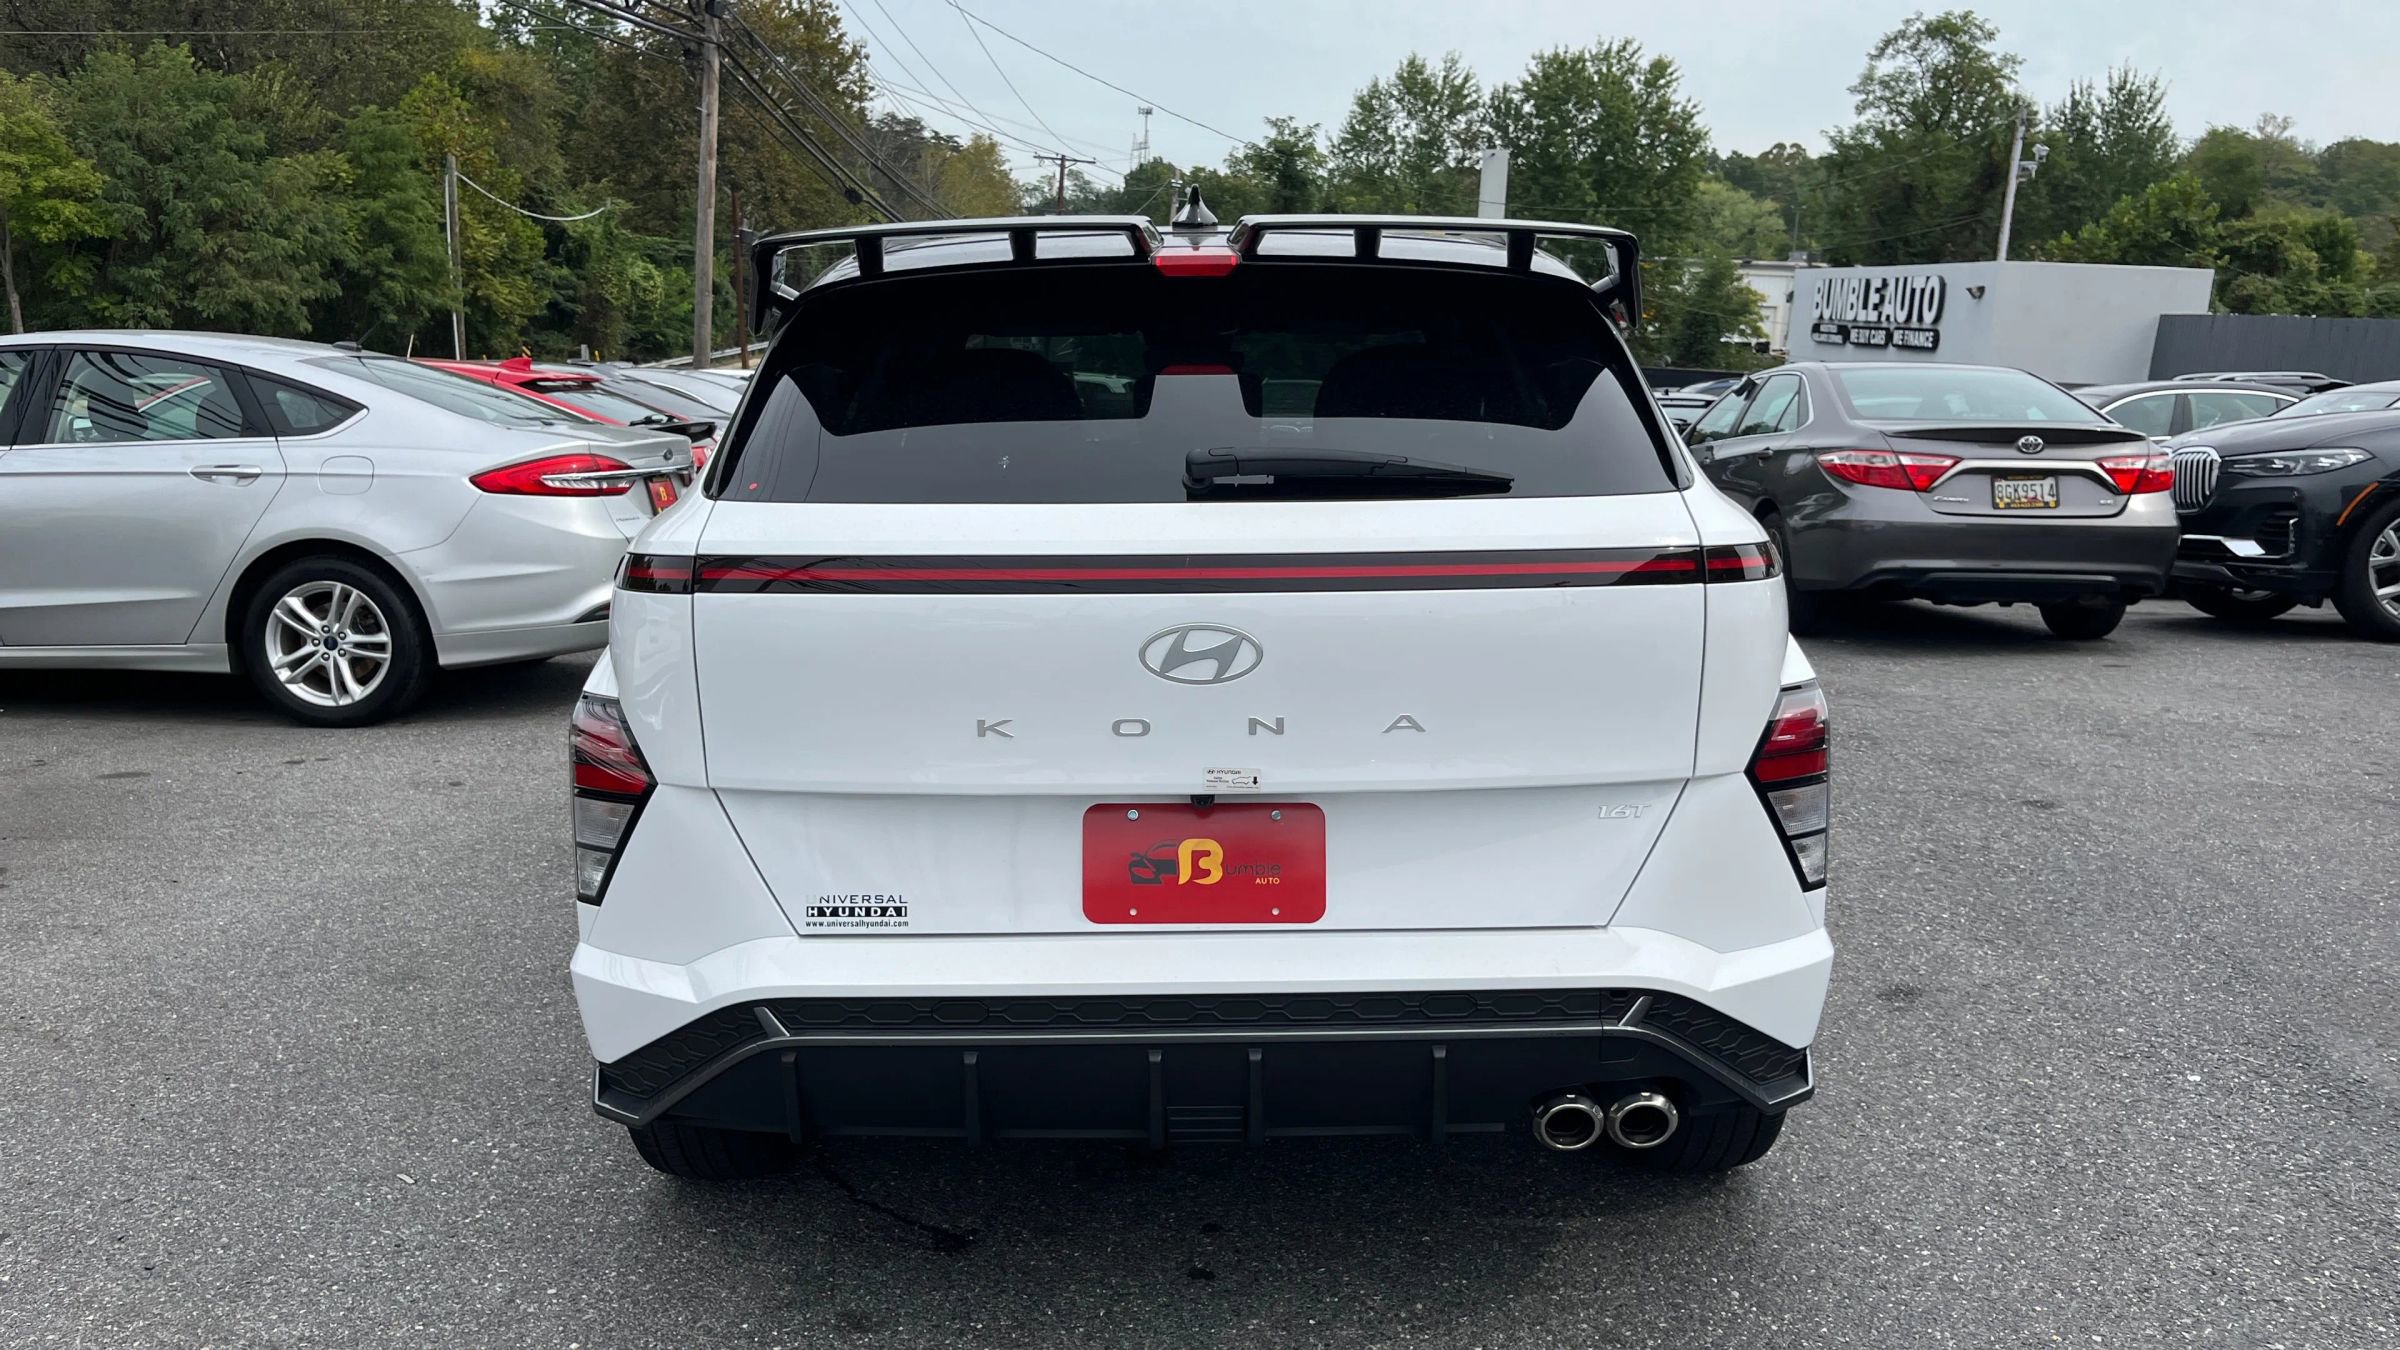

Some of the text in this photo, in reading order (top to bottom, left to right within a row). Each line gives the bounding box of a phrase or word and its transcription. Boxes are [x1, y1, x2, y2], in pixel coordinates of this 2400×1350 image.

[1812, 275, 1944, 325] BUMBLE AUTO
[1904, 329, 1935, 348] FINANCE
[1996, 483, 2056, 501] 8GK9514
[976, 713, 1427, 738] KONA
[1255, 877, 1280, 885] AUTO
[807, 906, 907, 917] HYUNDAI
[805, 919, 909, 928] www.universalhyundai.com
